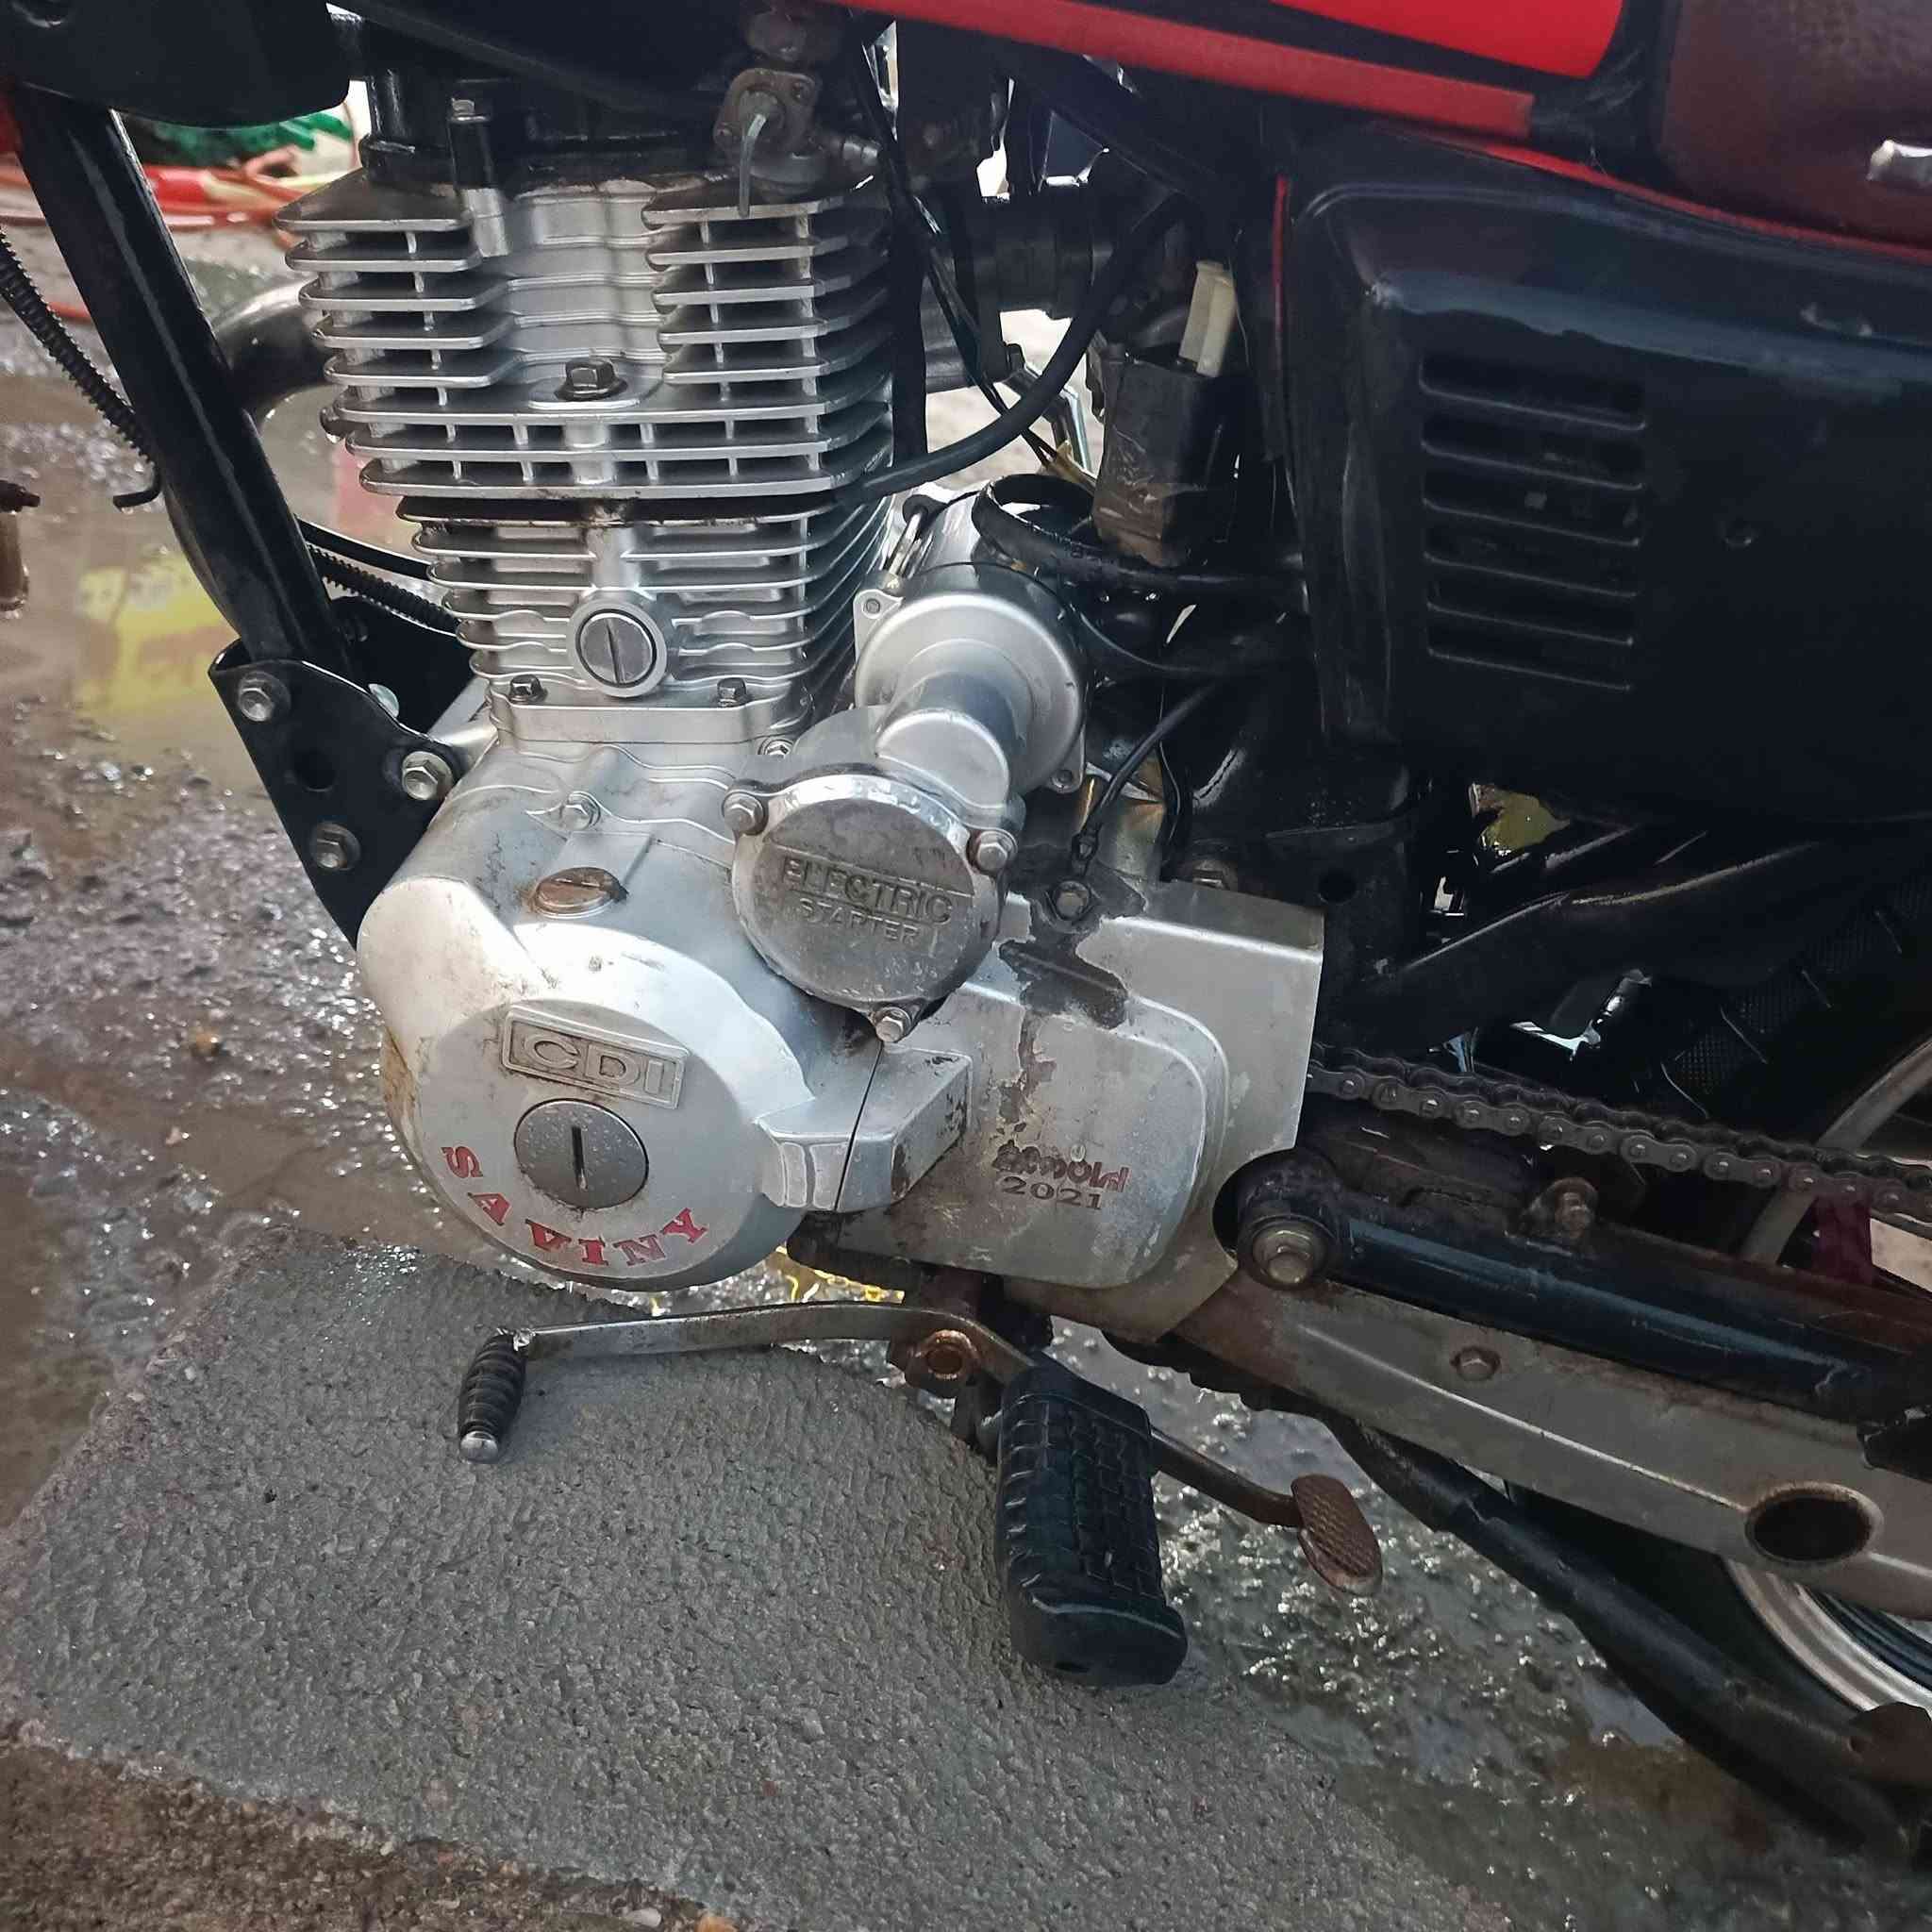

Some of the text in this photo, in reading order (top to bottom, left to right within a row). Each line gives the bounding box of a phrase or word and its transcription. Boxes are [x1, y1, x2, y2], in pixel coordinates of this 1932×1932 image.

[785, 856, 954, 925] ELECTRIC
[800, 897, 921, 945] STARTER
[527, 1036, 666, 1094] CDI
[441, 1145, 708, 1267] SAVINY
[1000, 1175, 1103, 1211] 2021
